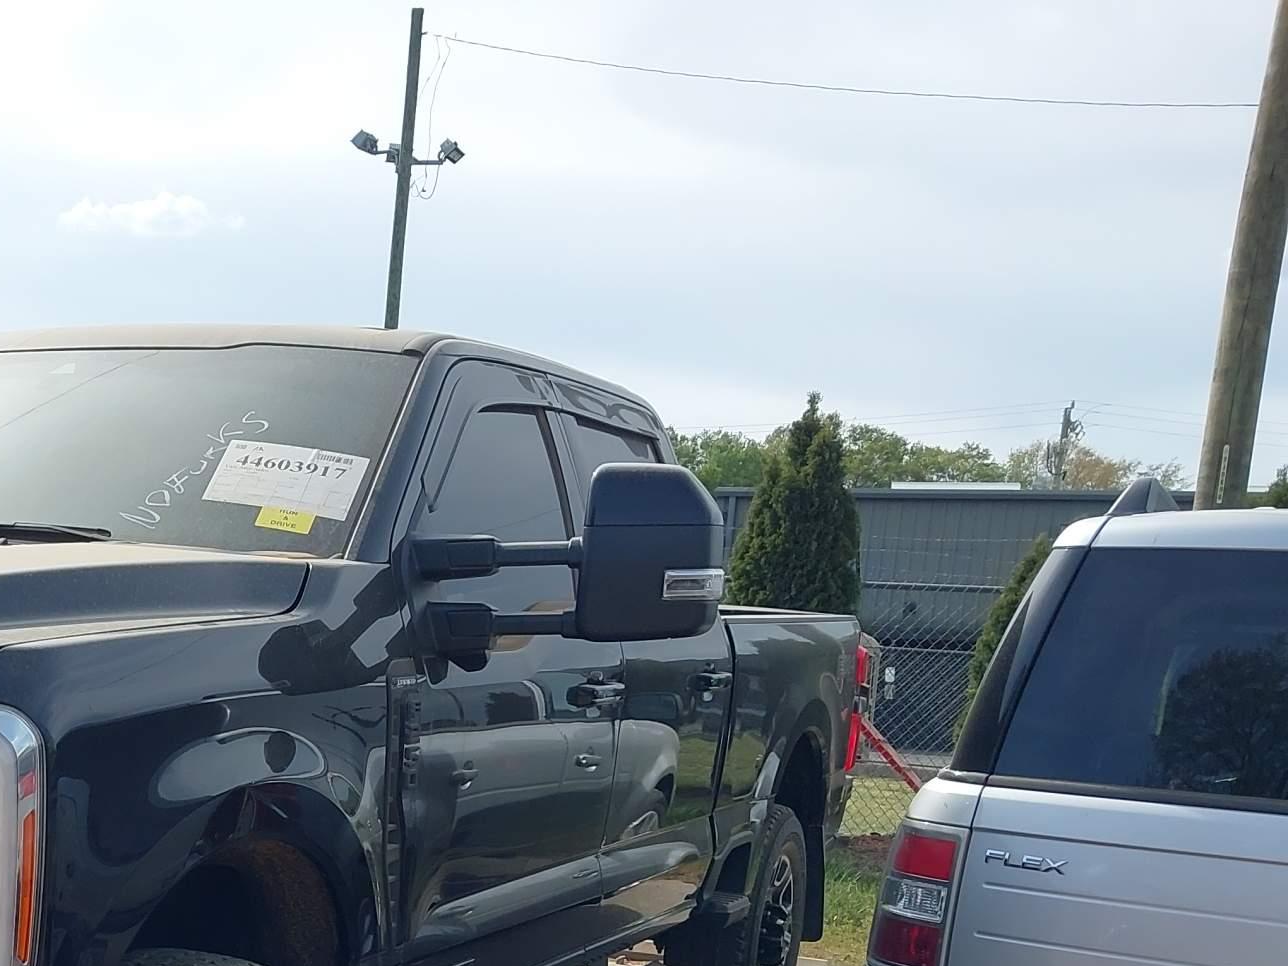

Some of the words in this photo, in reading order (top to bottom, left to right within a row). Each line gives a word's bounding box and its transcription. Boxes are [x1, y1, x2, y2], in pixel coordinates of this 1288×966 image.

[236, 454, 347, 480] 44603917
[270, 519, 297, 529] DRIVE
[984, 848, 1069, 876] FLEX
